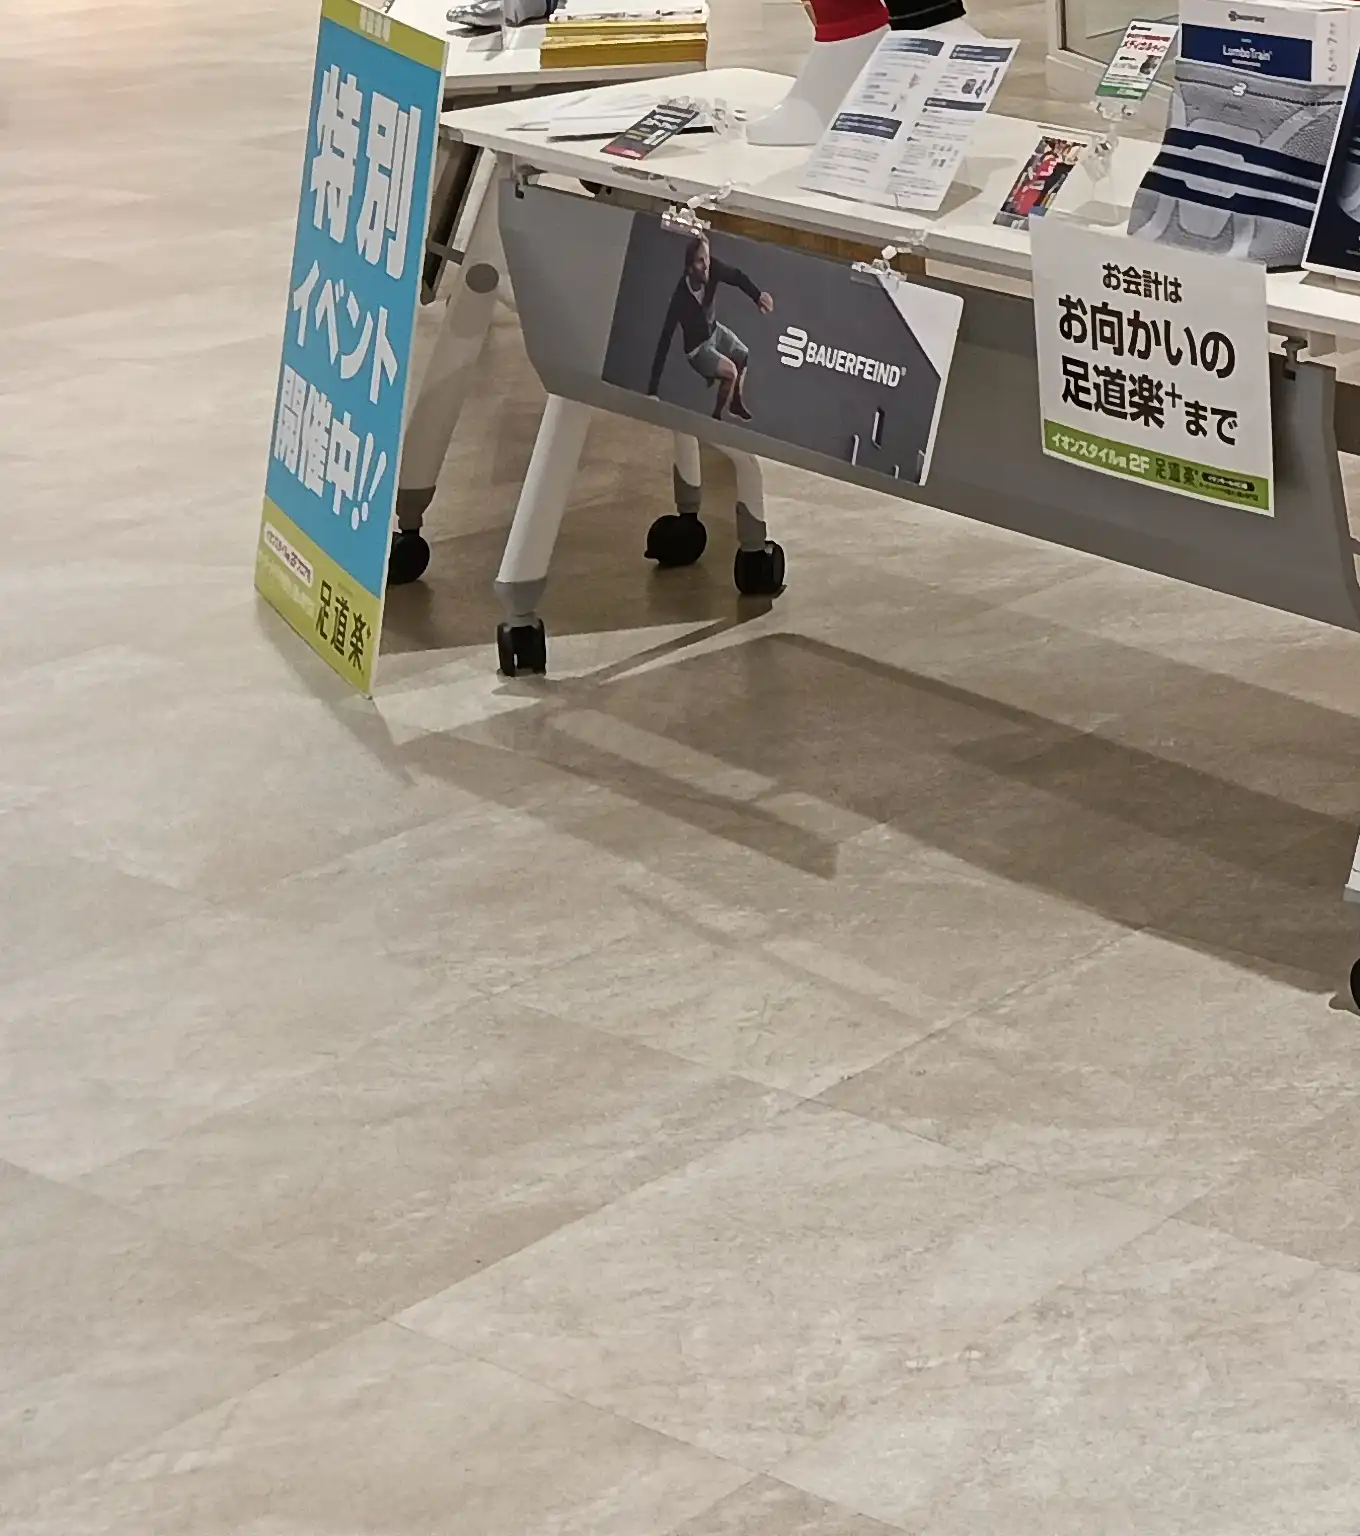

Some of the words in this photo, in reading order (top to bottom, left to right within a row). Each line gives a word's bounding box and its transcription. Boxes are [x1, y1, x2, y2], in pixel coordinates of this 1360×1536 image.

[311, 64, 421, 279] 特別
[293, 260, 398, 405] イベント
[1058, 294, 1236, 379] お向かいの
[1102, 262, 1183, 304] お会計は
[805, 341, 901, 388] BAUERFEIND
[274, 364, 387, 531] 開催中!!
